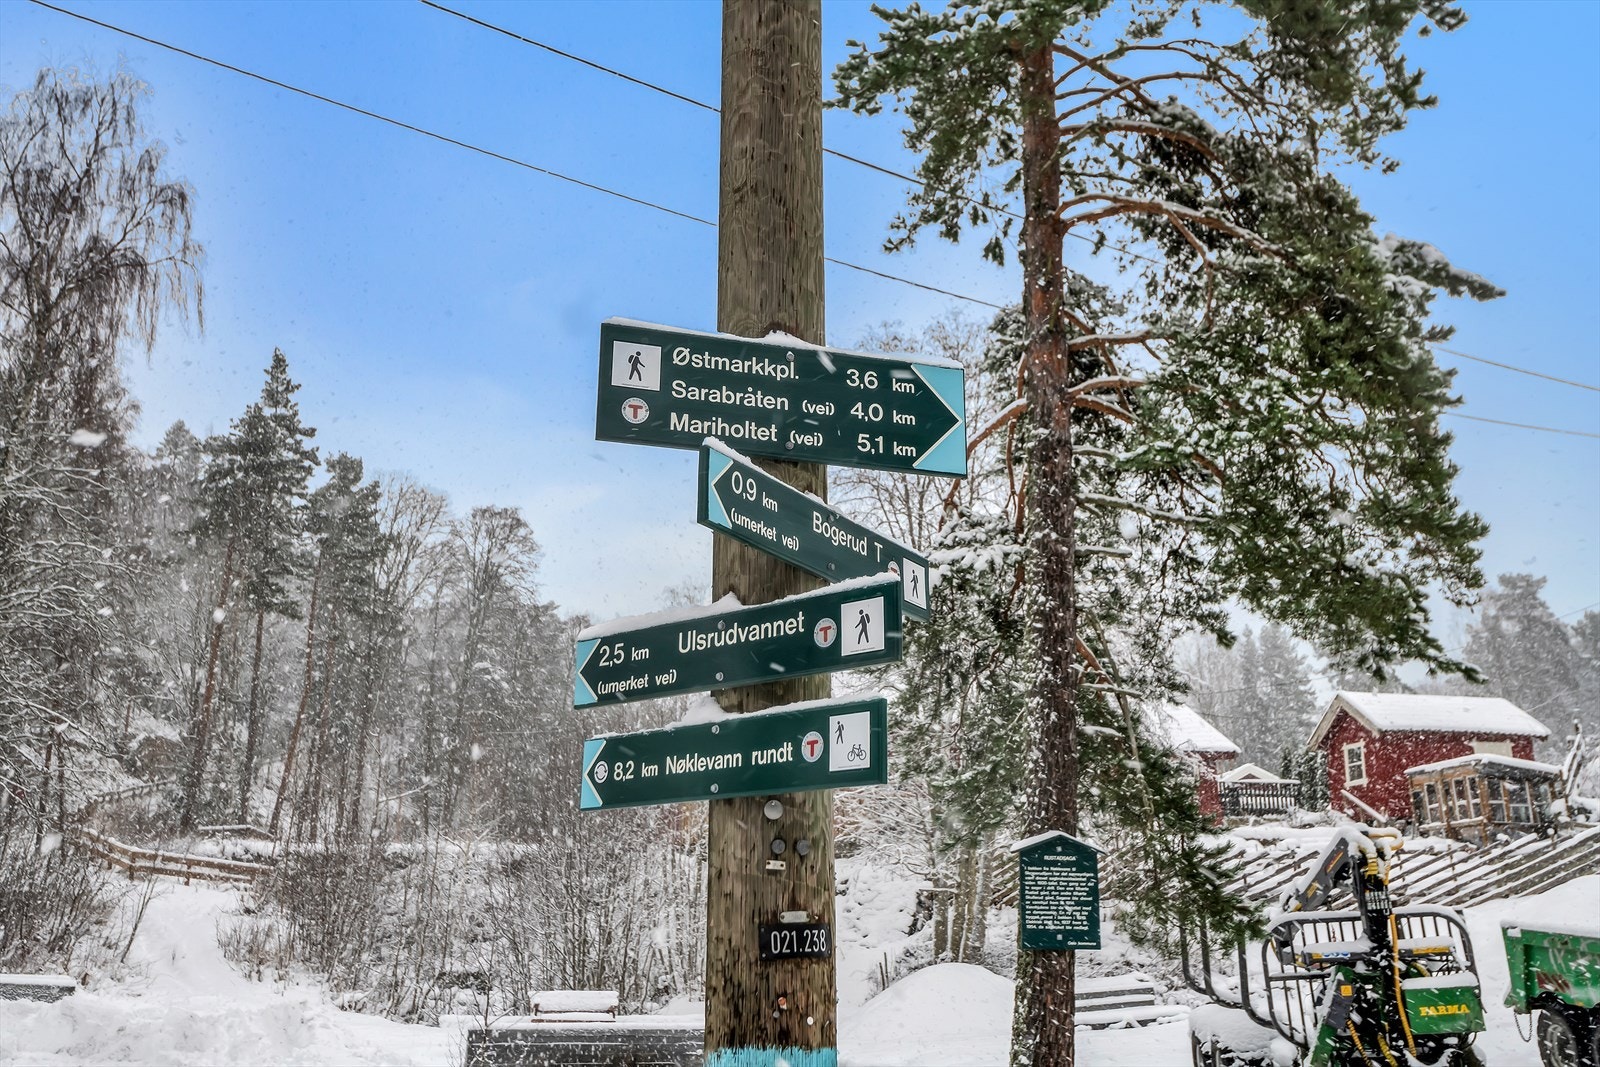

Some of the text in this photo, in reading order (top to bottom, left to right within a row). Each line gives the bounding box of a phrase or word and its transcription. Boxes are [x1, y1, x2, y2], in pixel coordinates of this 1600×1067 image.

[672, 346, 915, 394] Østmarkkpl. 3,6 km
[671, 380, 789, 411] Sarabråten
[802, 399, 835, 416] (vei)
[850, 402, 884, 422] 4,0
[892, 410, 916, 425] km
[669, 412, 916, 457] Mariholtet (vei) 5,1 km
[730, 507, 799, 551] (umerket vei)
[731, 471, 883, 563] 0,9 km Bogerud T
[599, 642, 625, 668] 2,5
[631, 647, 649, 661] km
[678, 611, 805, 654] Ulsrudvannet
[597, 669, 677, 695] (umerket vei)
[613, 760, 635, 782] 8,2
[641, 762, 658, 778] km
[665, 752, 742, 775] Nøklevann
[751, 741, 793, 766] rundt
[770, 929, 827, 954] 021.238
[1418, 1004, 1471, 1016] FARMA
